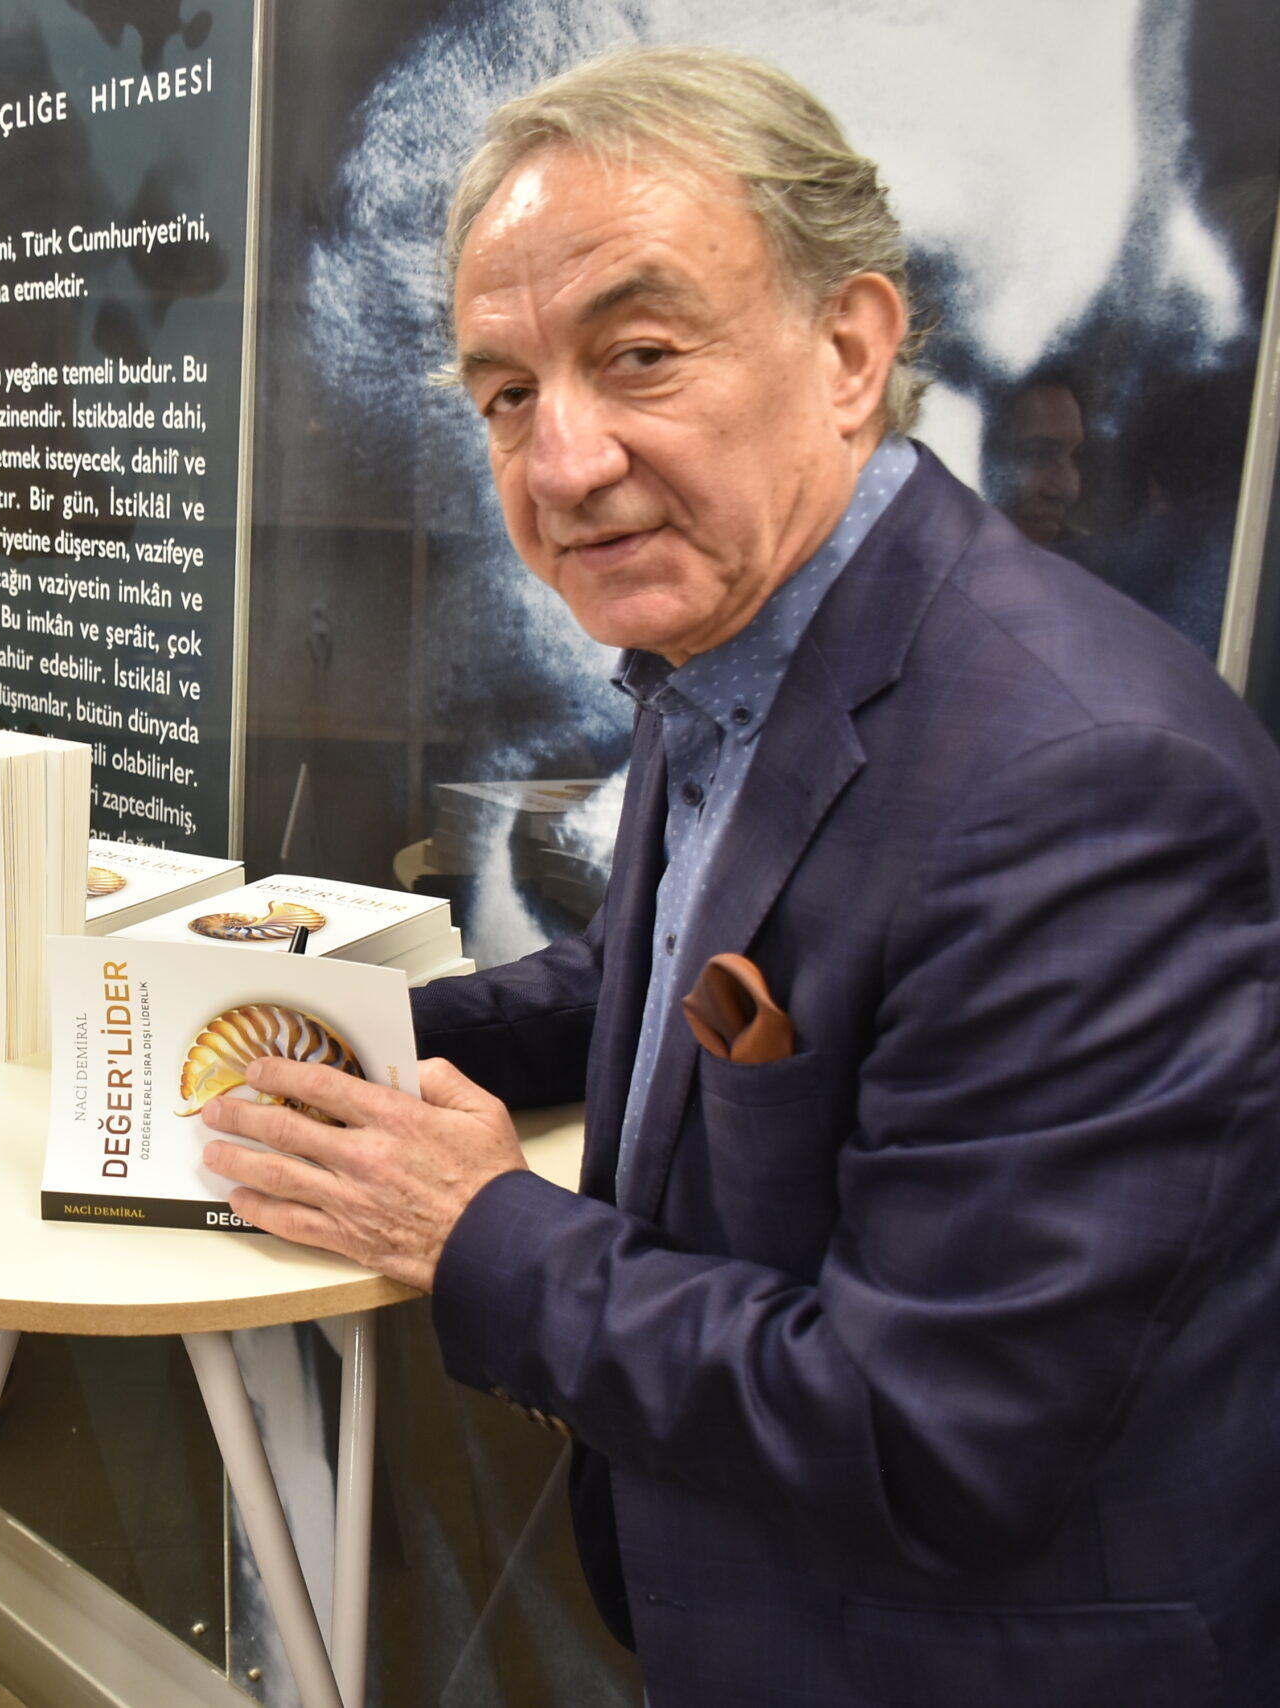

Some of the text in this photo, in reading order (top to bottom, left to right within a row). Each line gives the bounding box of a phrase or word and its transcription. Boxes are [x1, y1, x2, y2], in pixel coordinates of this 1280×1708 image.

[92, 58, 212, 113] HİTABESİ
[22, 231, 62, 258] Türk
[15, 273, 88, 300] etmektir.
[5, 362, 58, 392] yegâne
[62, 358, 113, 385] temeli
[120, 357, 176, 385] budur.
[183, 355, 207, 383] Bu
[72, 399, 155, 429] İstikbalde
[162, 402, 206, 433] dahi,
[45, 446, 125, 477] isteyecek,
[131, 448, 179, 475] dahilî
[185, 455, 206, 475] ve
[30, 486, 54, 512] Bir
[63, 492, 98, 520] gün,
[110, 486, 170, 520] İstiklâl
[182, 500, 205, 521] ve
[55, 530, 130, 563] düşersen,
[135, 538, 204, 573] vazifeye
[38, 574, 109, 602] vaziyetin
[119, 579, 171, 610] imkân
[181, 591, 203, 612] ve
[1, 604, 20, 630] Bu
[26, 609, 73, 638] imkân
[80, 621, 99, 641] ve
[106, 622, 159, 652] şerâit,
[167, 629, 202, 658] çok
[40, 655, 106, 685] edebilir.
[114, 659, 170, 696] İstiklâl
[179, 678, 200, 700] ve
[76, 697, 122, 729] bütün
[128, 708, 199, 745] dünyada
[112, 748, 198, 787] olabilirler.
[103, 792, 196, 835] zaptedilmiş,
[75, 1013, 87, 1121] NACİ DEMİRAL
[98, 961, 133, 1178] DEĞER'LİDER
[140, 981, 152, 1160] ÖZDEĞERLERLE SIRA DIŞI LİDERLİK
[64, 1205, 144, 1218] NACİ DEMİRAL
